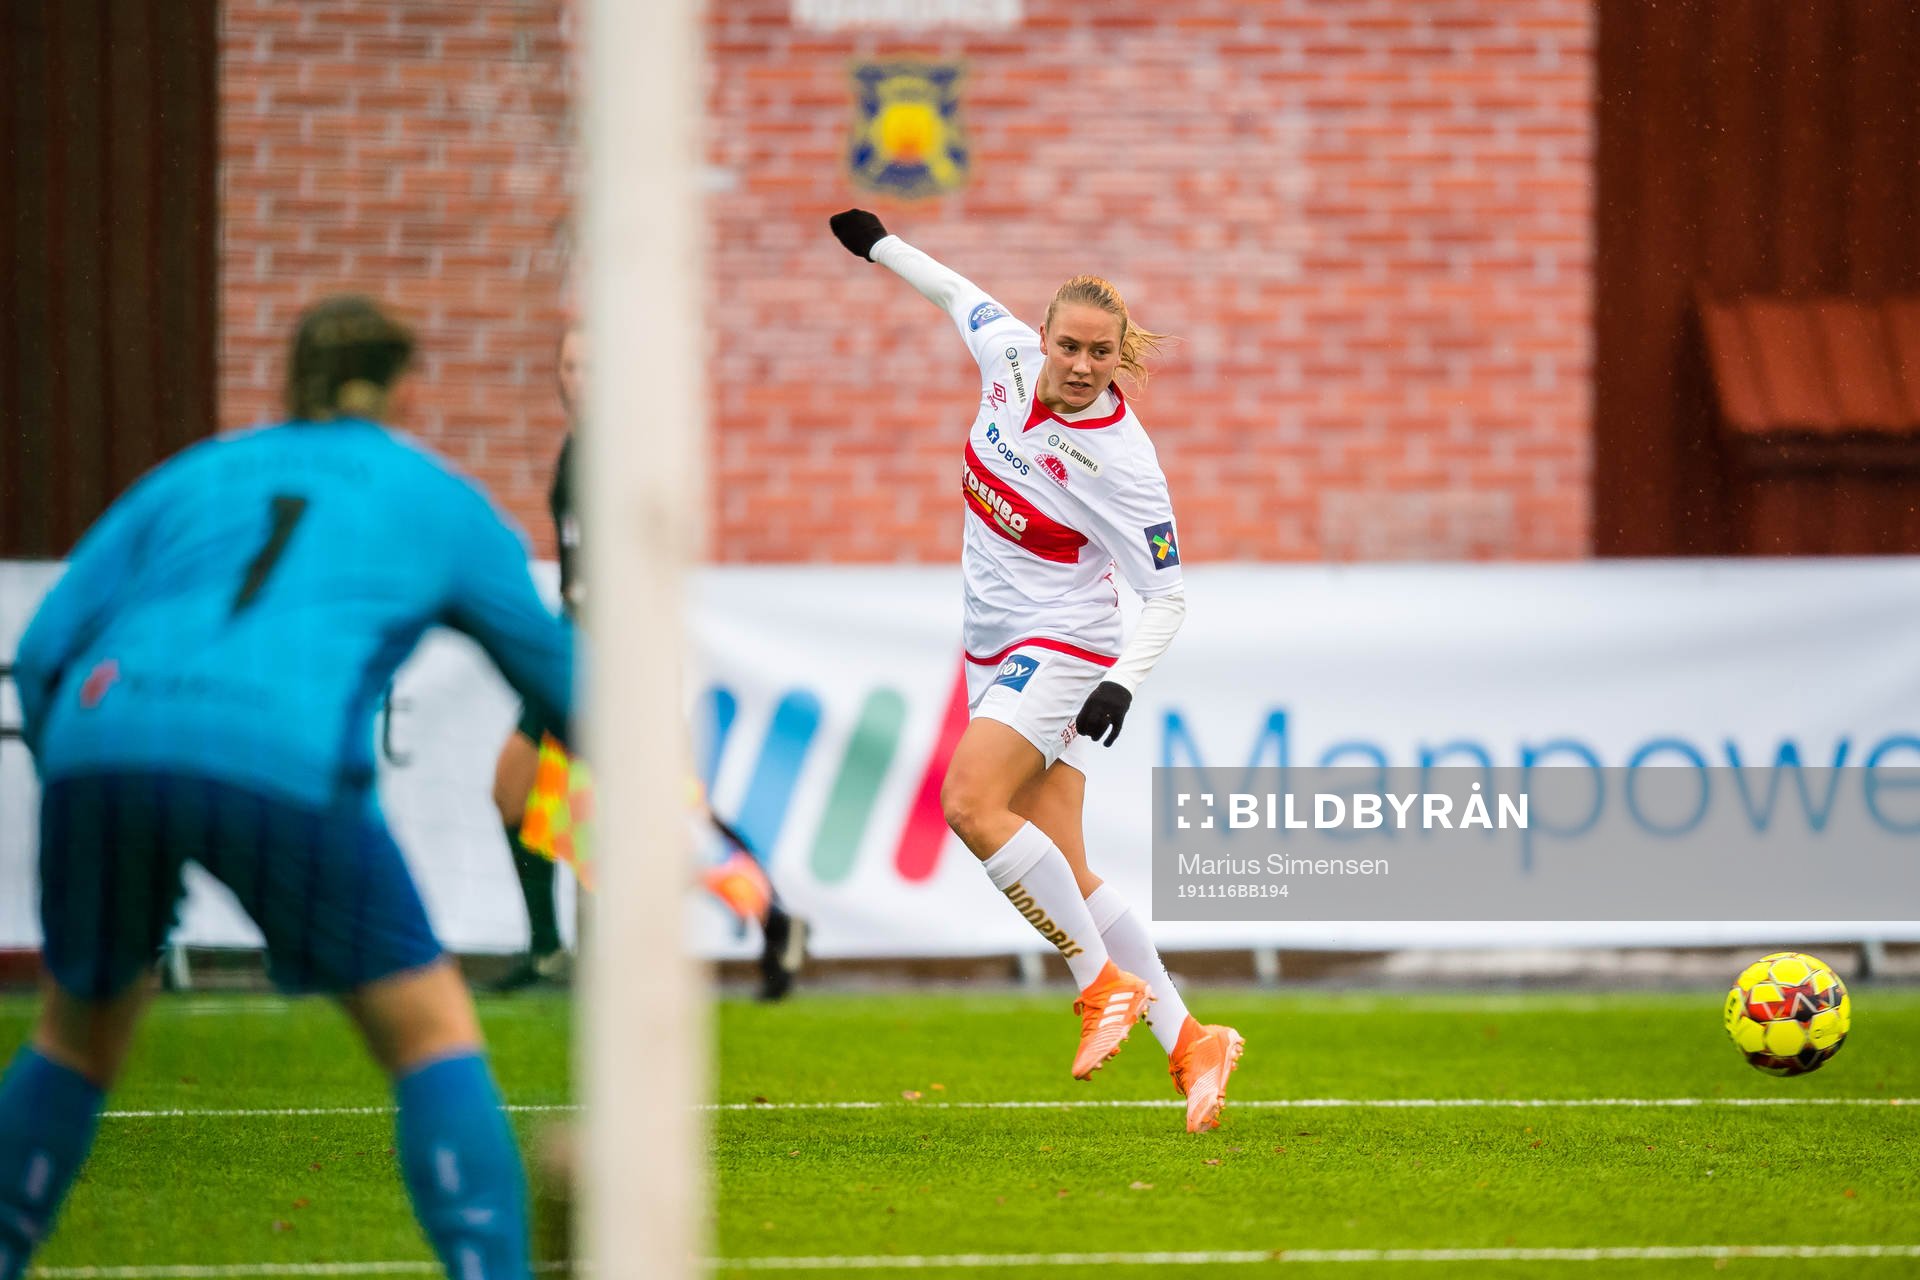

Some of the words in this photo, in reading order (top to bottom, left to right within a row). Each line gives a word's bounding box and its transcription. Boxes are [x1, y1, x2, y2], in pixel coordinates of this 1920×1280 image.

[998, 442, 1030, 476] OBOS
[963, 463, 1028, 532] YDENBØ
[231, 494, 308, 618] 1
